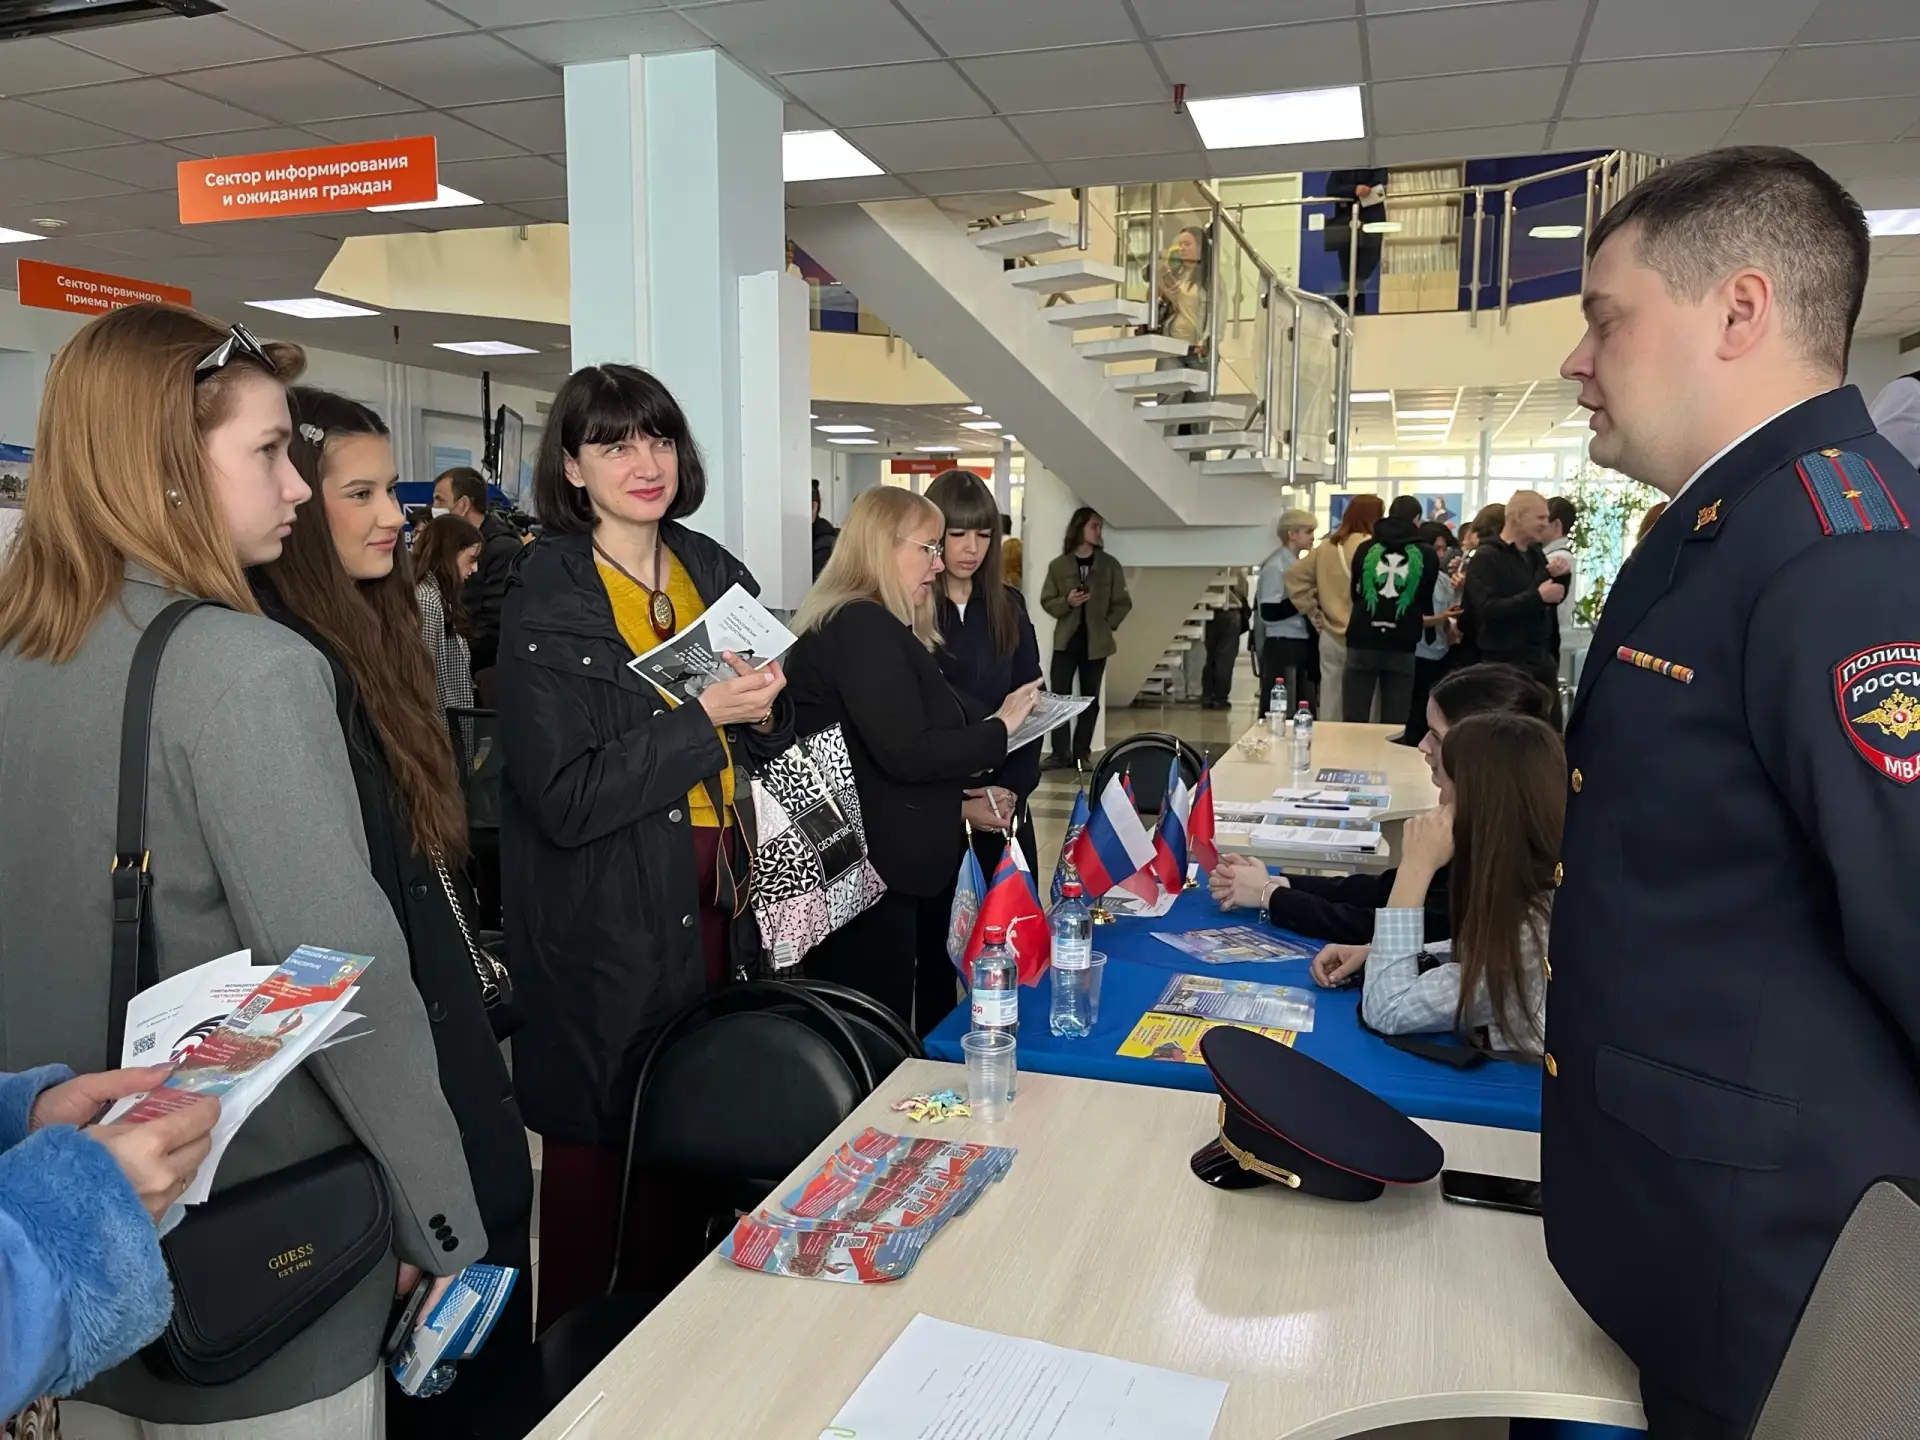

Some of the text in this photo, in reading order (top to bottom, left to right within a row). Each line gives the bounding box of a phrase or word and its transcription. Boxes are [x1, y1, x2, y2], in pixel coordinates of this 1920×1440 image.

[205, 155, 408, 187] Сектор информирования
[223, 178, 393, 206] и ожидания граждан
[56, 276, 162, 303] Сектор первичного
[65, 293, 108, 308] приема
[817, 823, 853, 852] GEOMETRIC
[268, 1242, 314, 1269] GUESS
